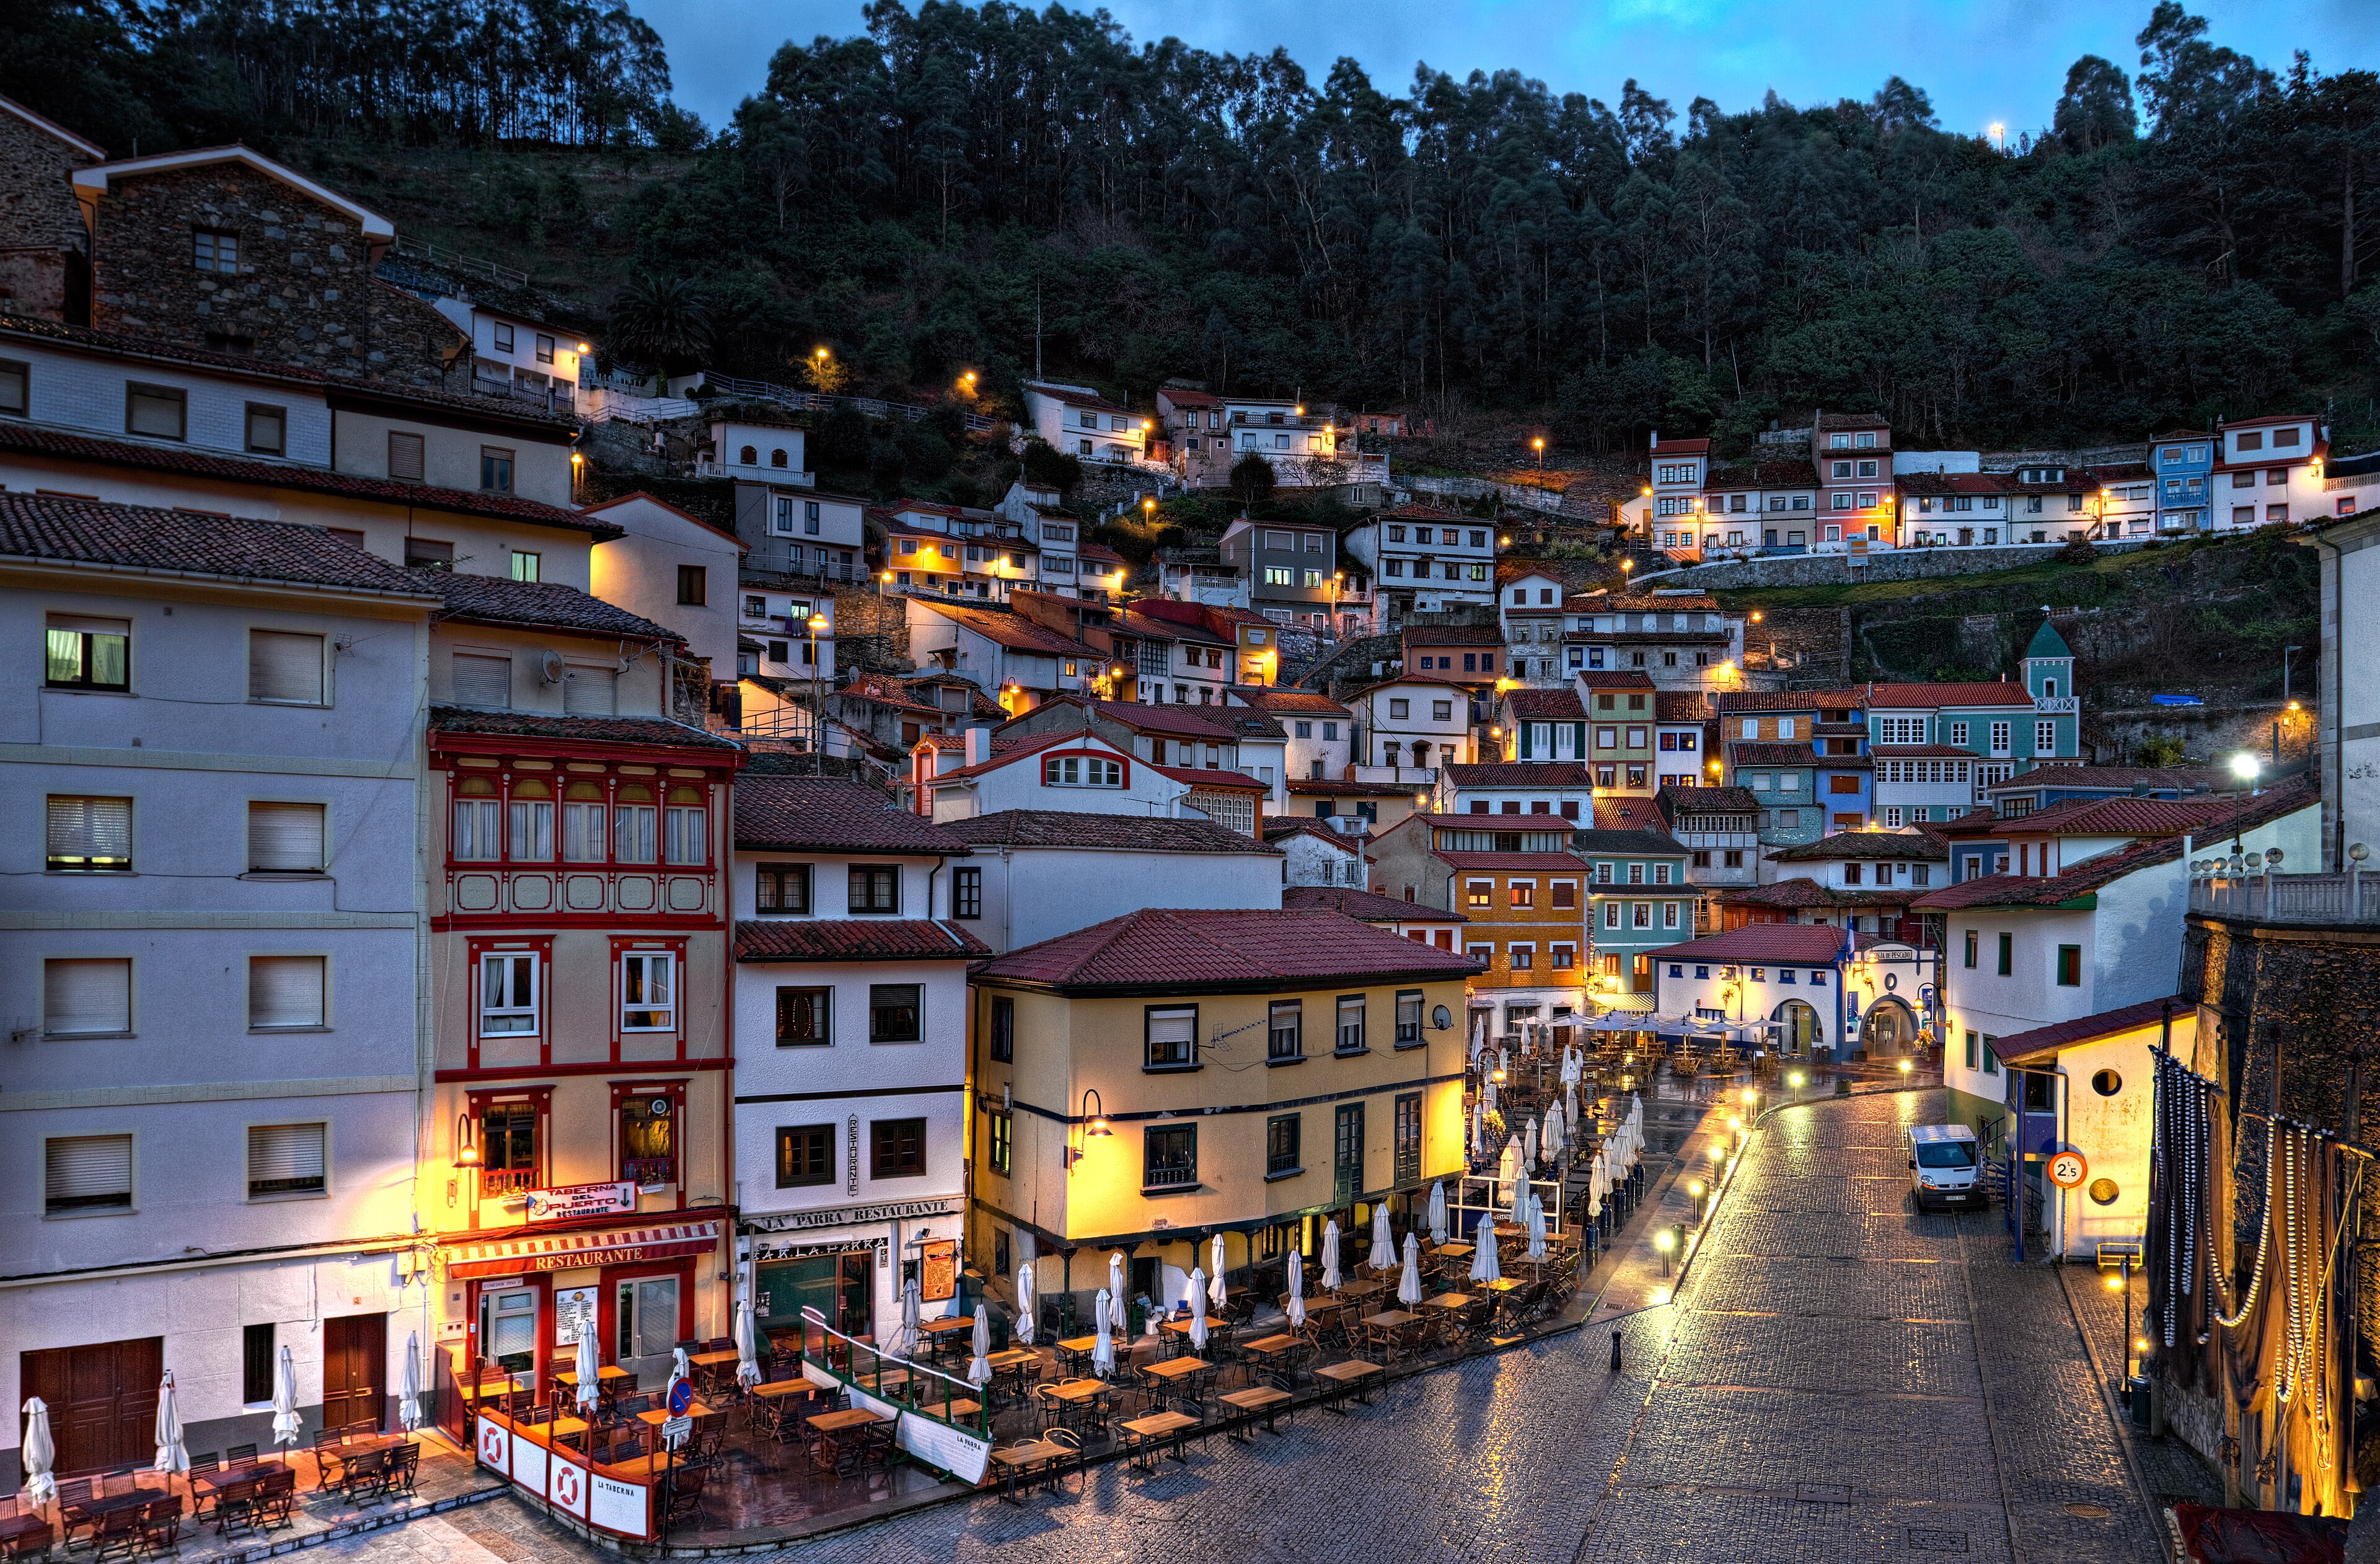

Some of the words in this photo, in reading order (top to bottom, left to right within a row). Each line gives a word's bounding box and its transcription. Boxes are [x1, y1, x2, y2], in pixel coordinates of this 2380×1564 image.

[547, 1184, 617, 1196] TABERNA
[549, 1197, 617, 1211] PUERTO
[557, 1206, 609, 1217] RESTAURANTE
[767, 1218, 785, 1229] LA
[796, 1213, 843, 1226] PARRA
[854, 1201, 948, 1220] RESTAURANTE
[795, 1247, 818, 1257] LA
[536, 1248, 643, 1270] RESTAURANTE
[957, 1435, 964, 1444] LA
[964, 1439, 981, 1451] PARRA
[606, 1483, 634, 1496] TABERNA
